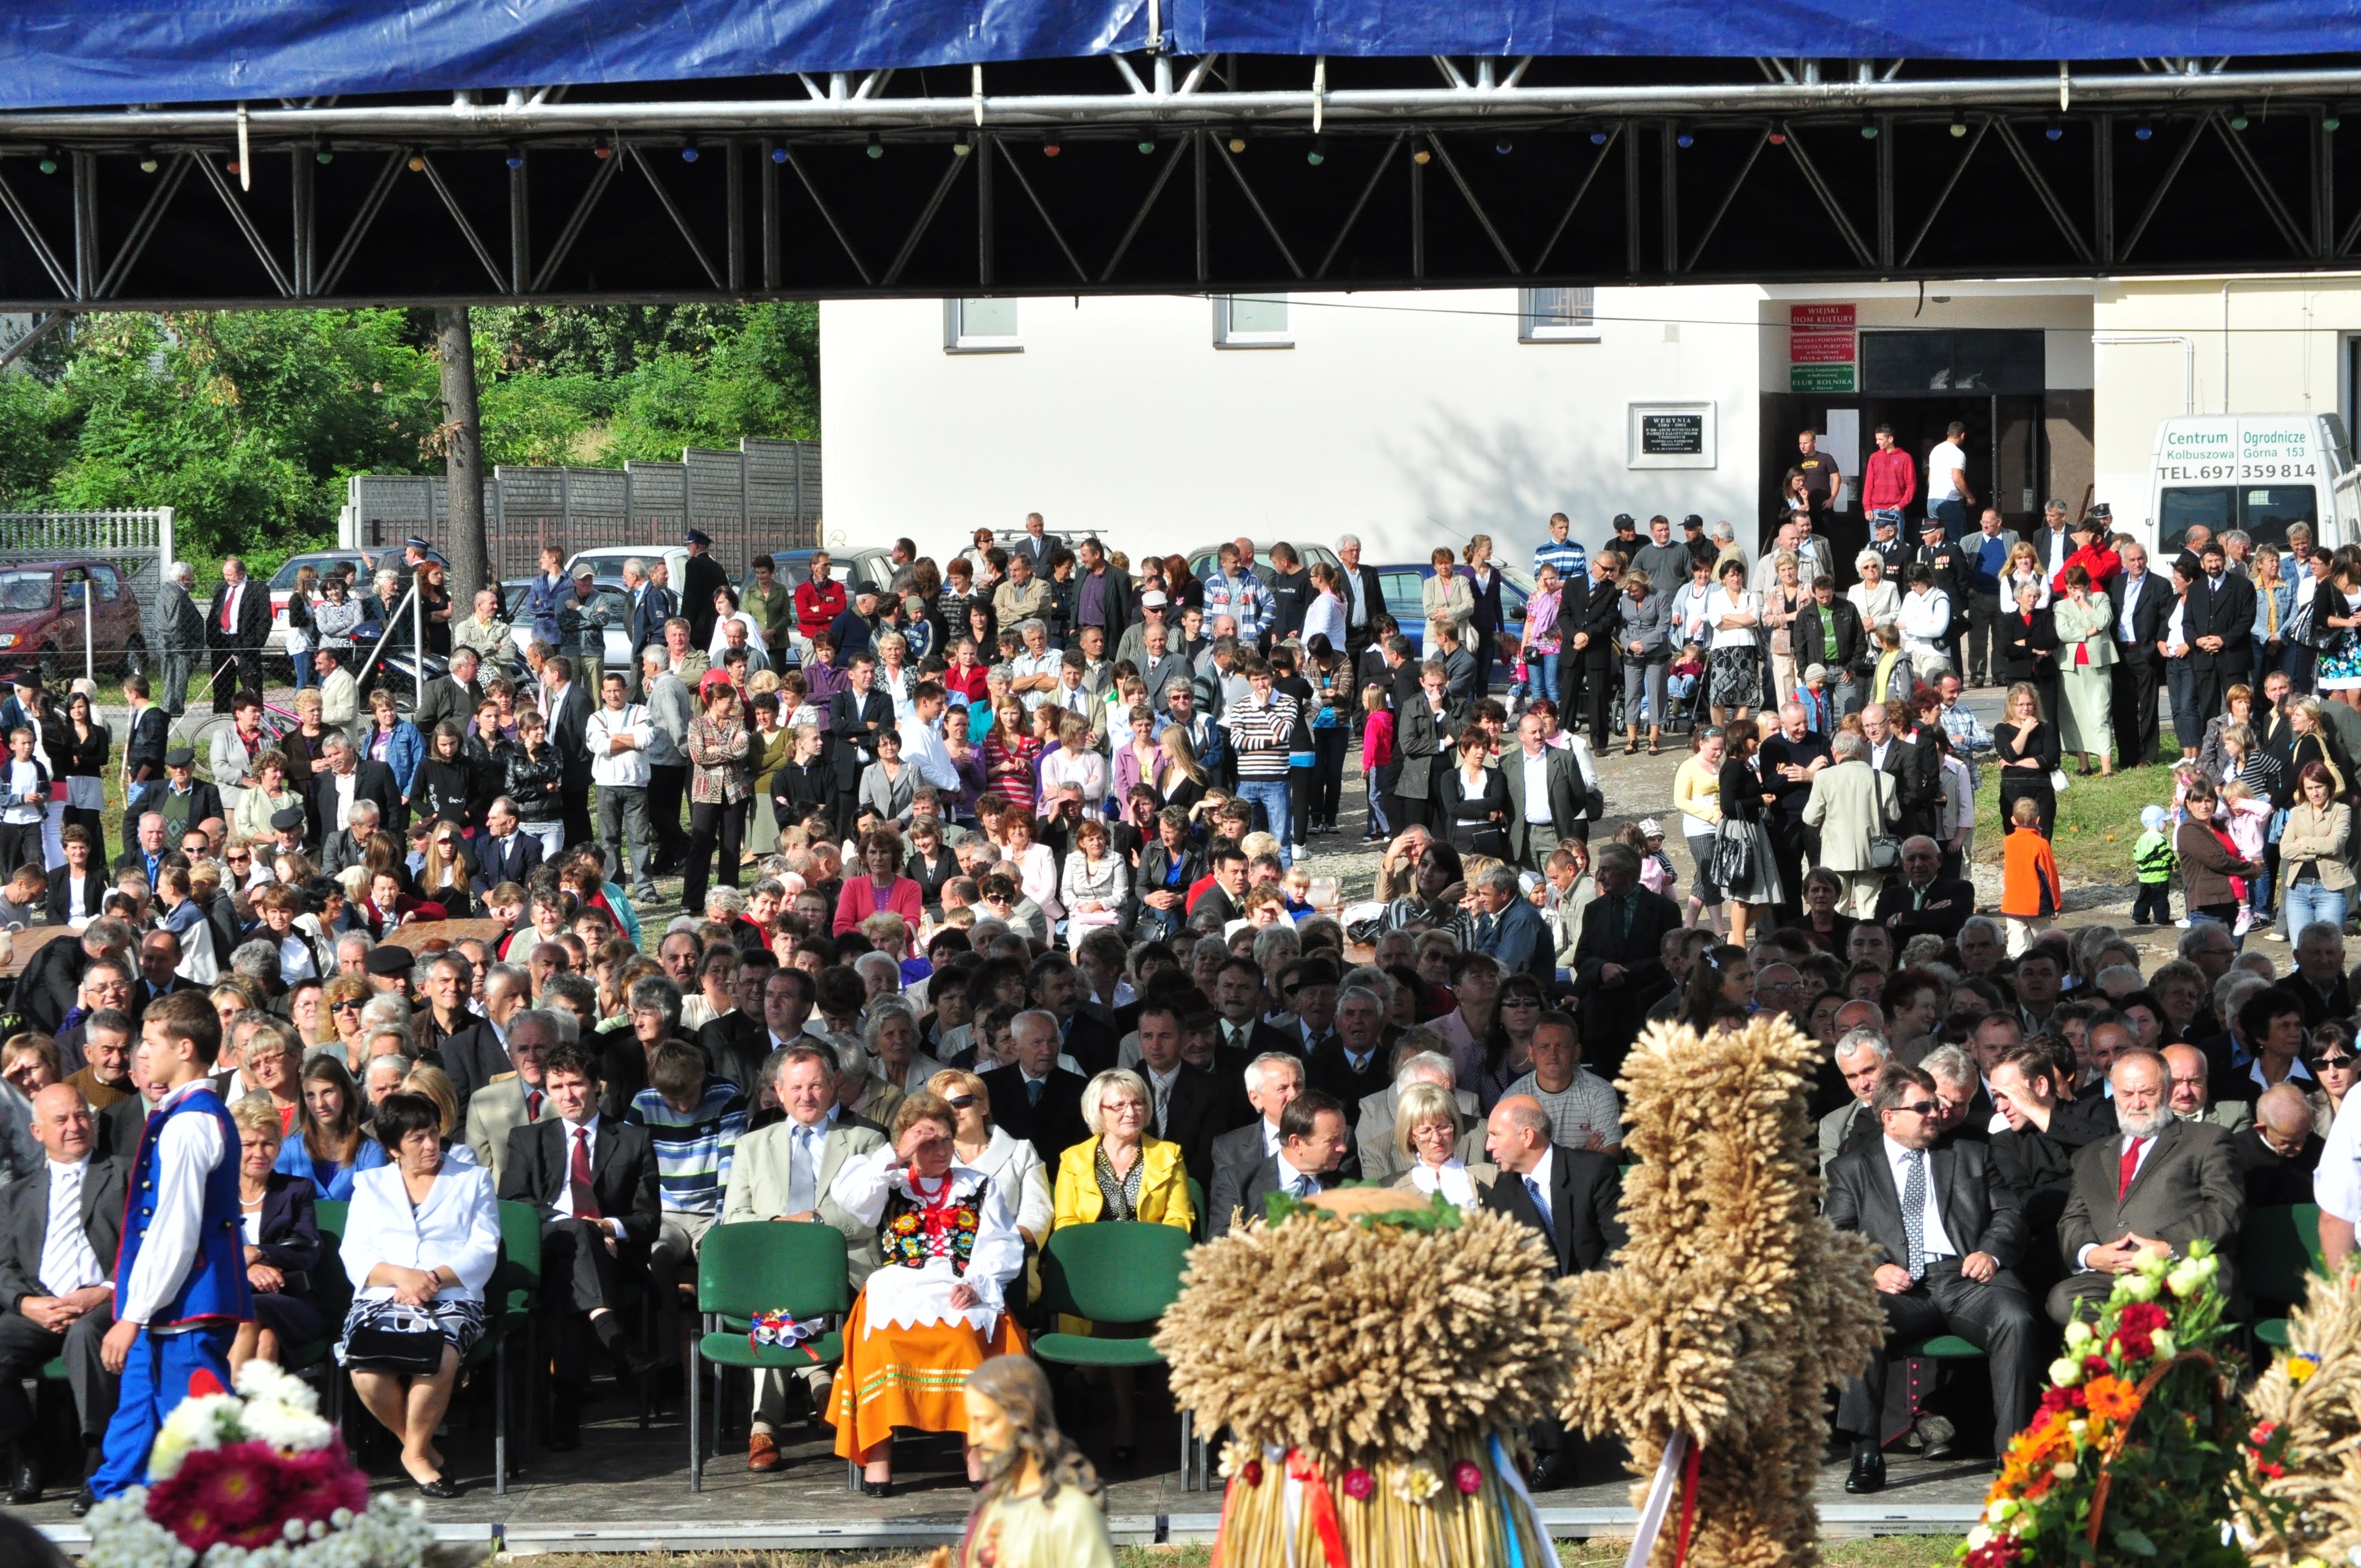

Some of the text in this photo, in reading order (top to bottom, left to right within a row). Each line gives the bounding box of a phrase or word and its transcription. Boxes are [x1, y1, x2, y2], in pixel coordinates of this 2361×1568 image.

[2168, 431, 2305, 447] Centrum Ogrodnicze
[2167, 447, 2304, 459] Kolbuszowa Górna 153
[2241, 465, 2276, 478] 359
[2281, 464, 2316, 478] 814
